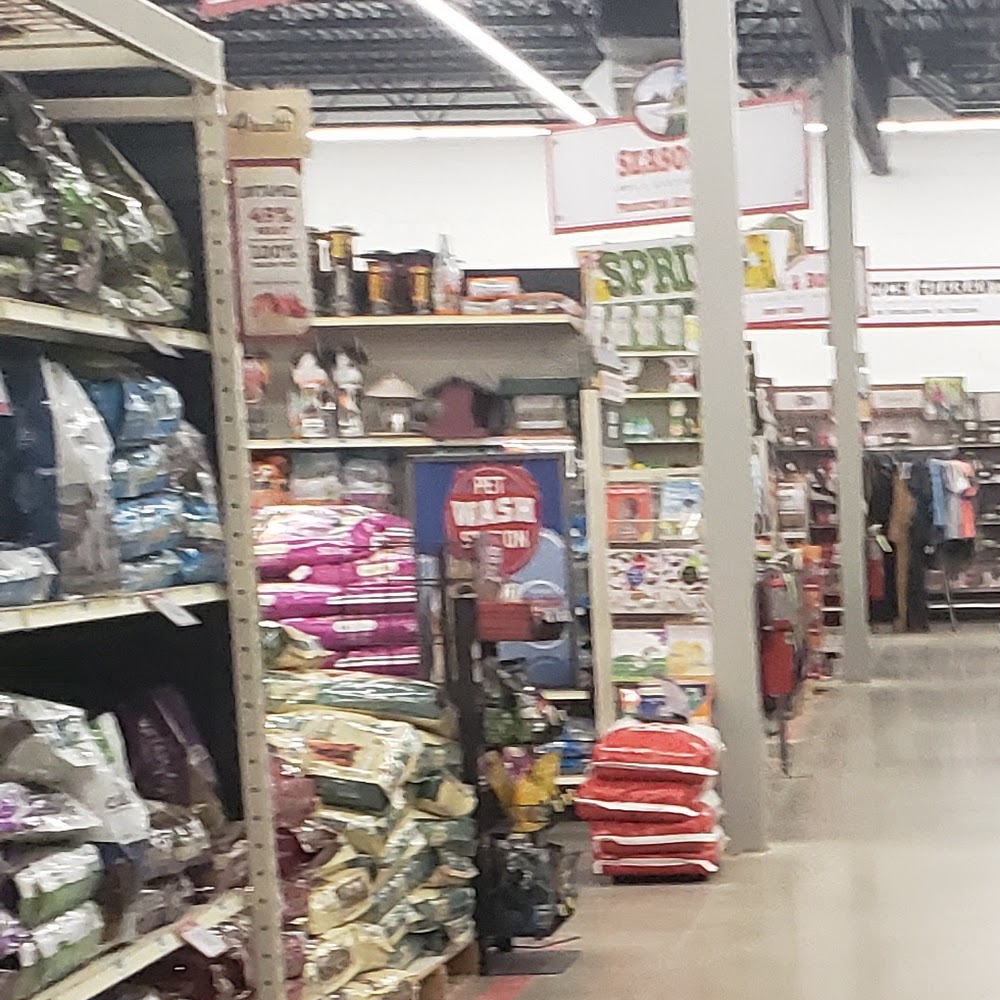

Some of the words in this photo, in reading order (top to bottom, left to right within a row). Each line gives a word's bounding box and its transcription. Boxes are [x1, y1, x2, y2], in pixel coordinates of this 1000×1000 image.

[616, 144, 691, 177] SEASO
[600, 244, 696, 298] SPRI
[450, 497, 538, 528] WASH
